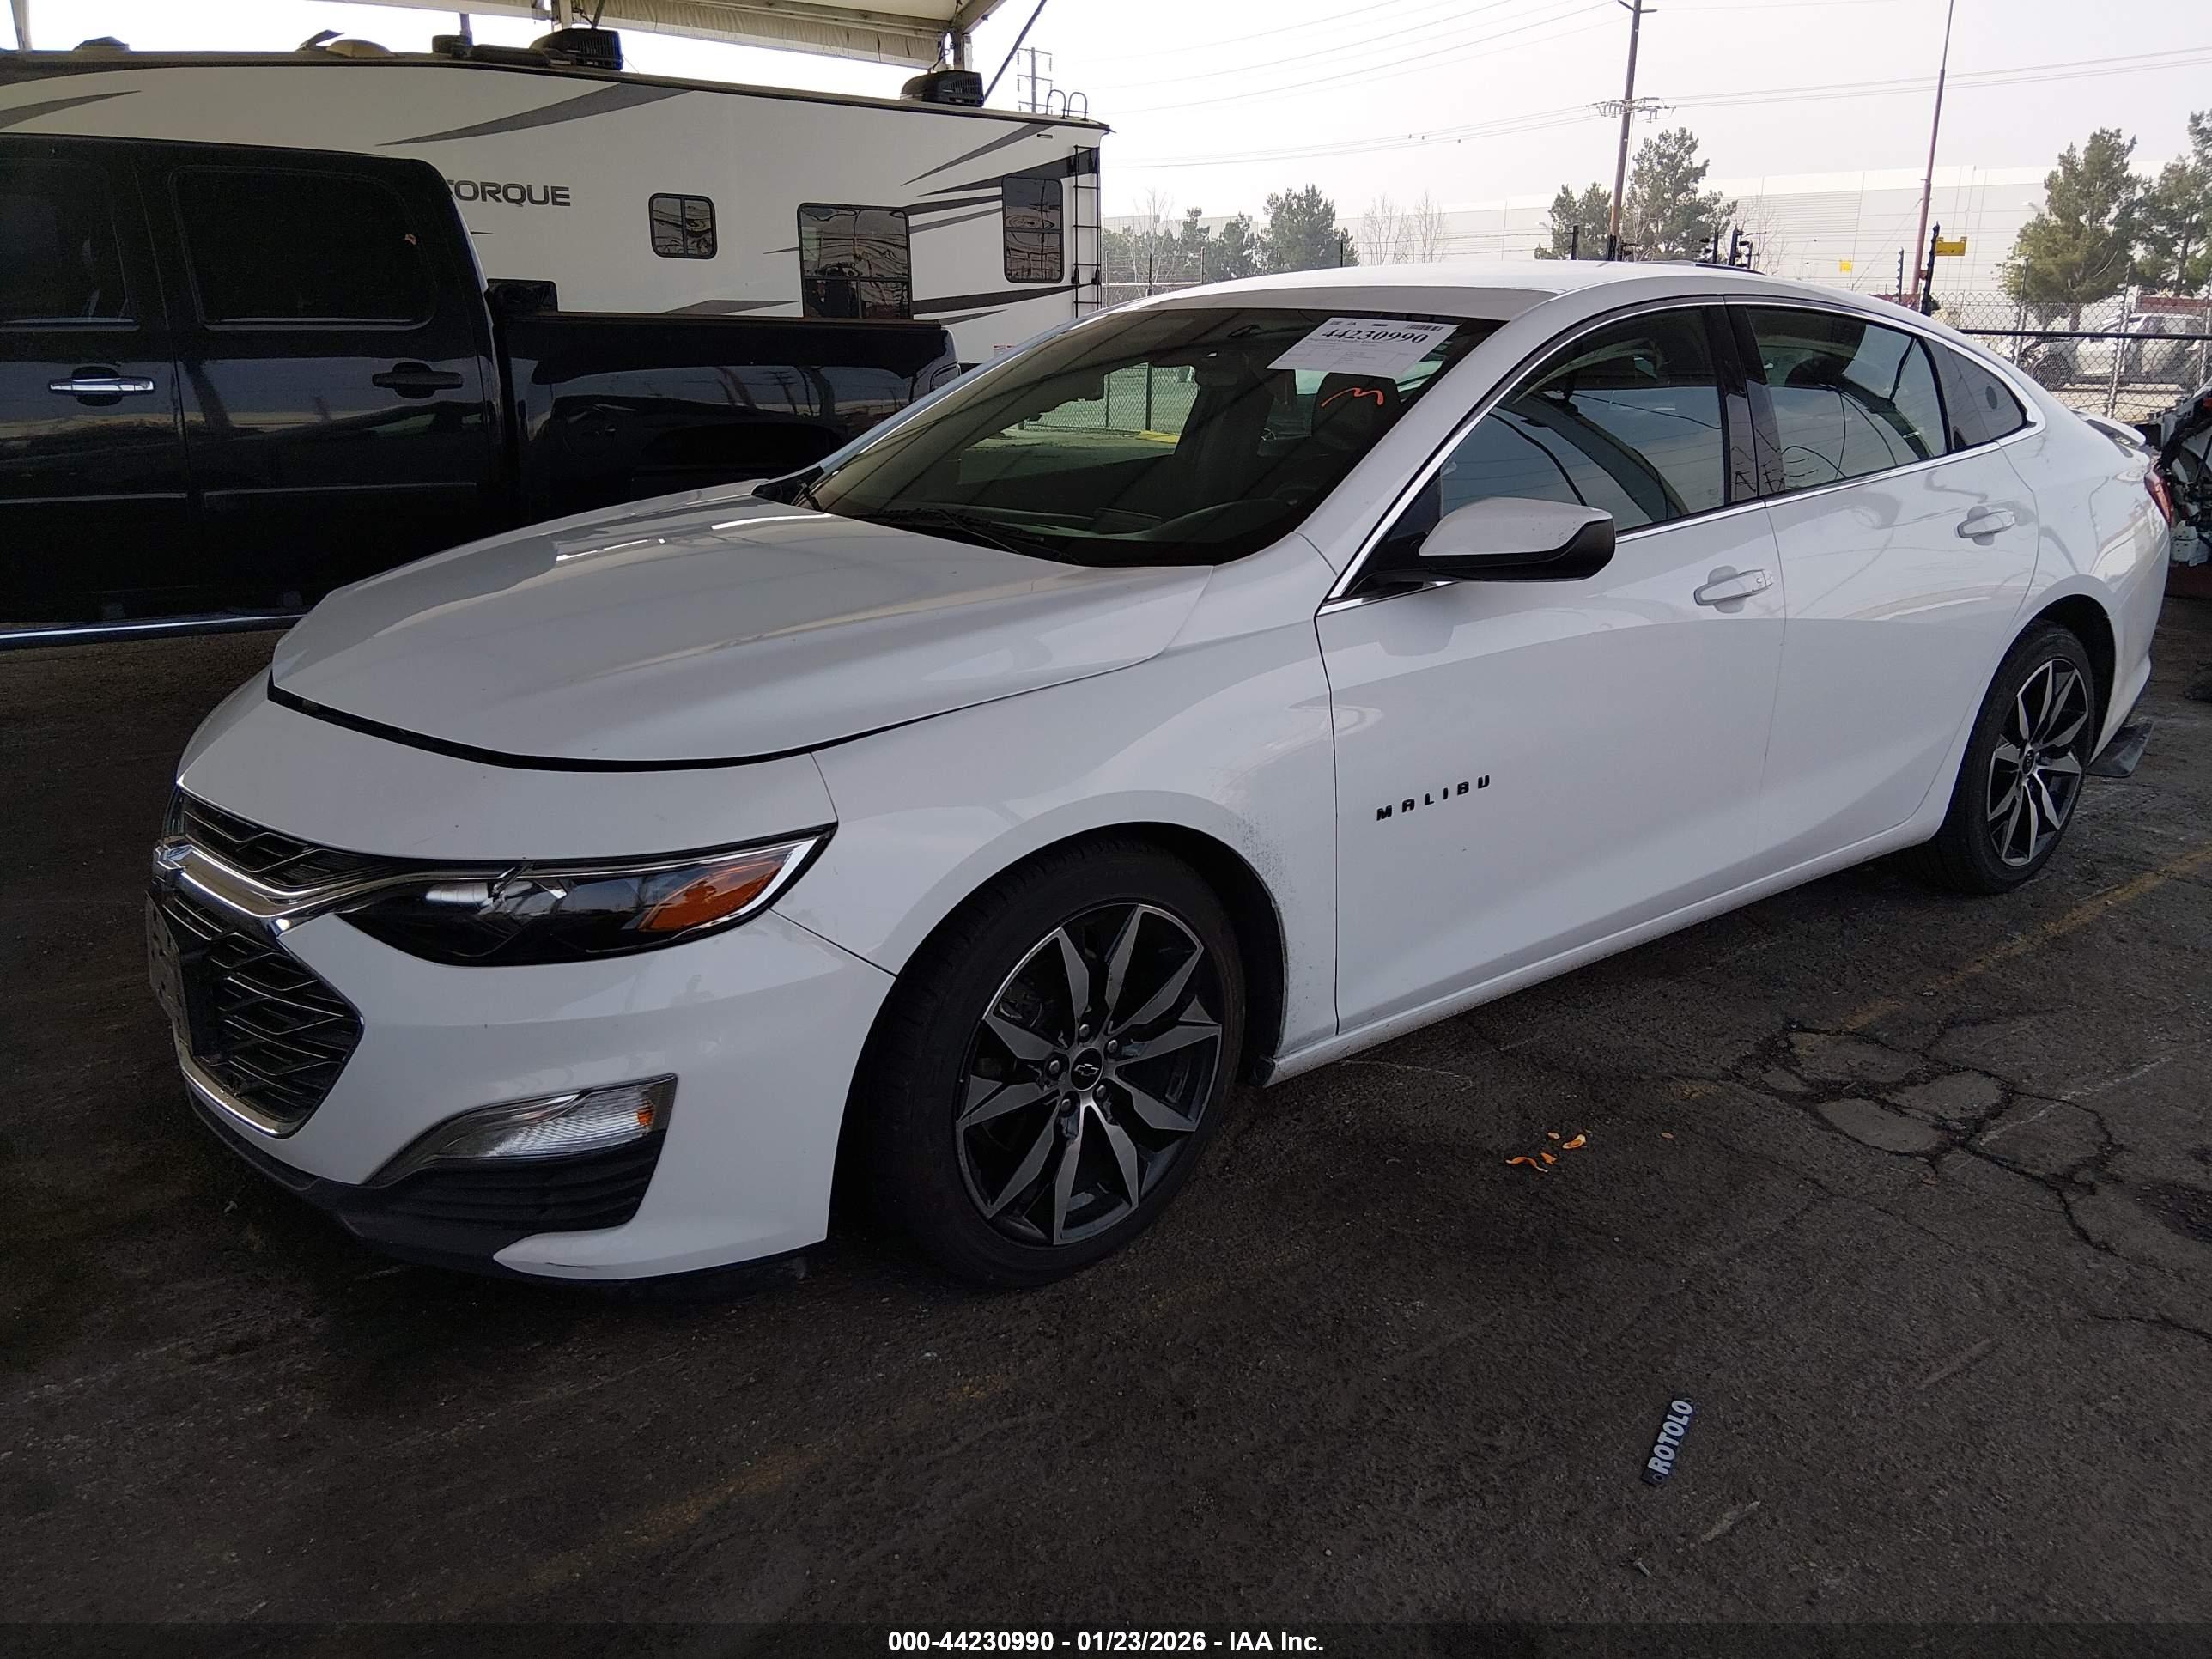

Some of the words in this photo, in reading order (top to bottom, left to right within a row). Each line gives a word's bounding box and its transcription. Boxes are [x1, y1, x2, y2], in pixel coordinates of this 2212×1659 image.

[446, 179, 571, 207] ORQUE
[1322, 328, 1429, 344] 44230990
[1376, 775, 1491, 822] MALIBU
[1647, 1400, 1693, 1475] ROTOLO
